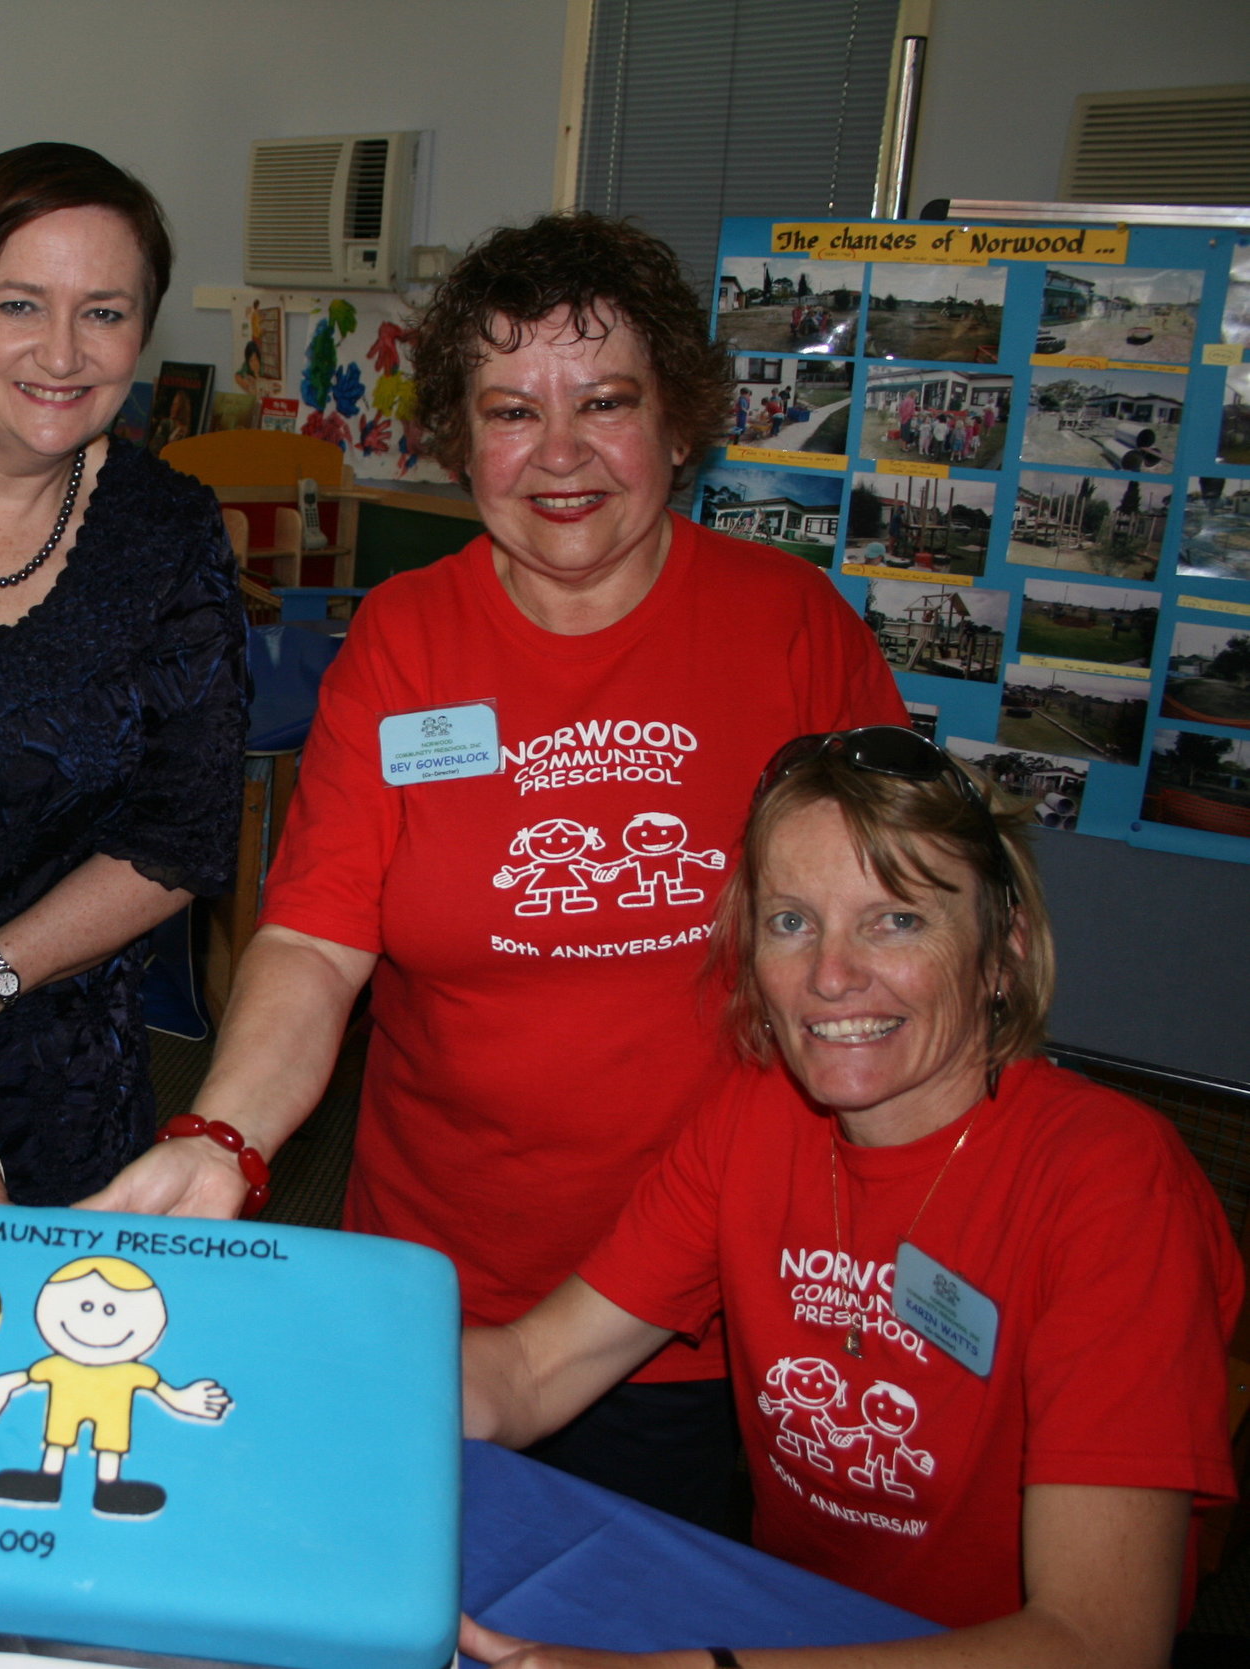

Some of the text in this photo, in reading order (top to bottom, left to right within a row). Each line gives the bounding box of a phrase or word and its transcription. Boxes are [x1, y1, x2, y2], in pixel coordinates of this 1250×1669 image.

[777, 230, 819, 250] The
[830, 226, 916, 251] changes
[931, 229, 955, 252] of
[970, 229, 1086, 254] Norwood
[390, 751, 489, 774] BEV GOWENLOCK
[500, 719, 698, 770] NORWOOD
[514, 749, 684, 785] COMMUNITY
[520, 766, 682, 797] PRESCHOOL
[491, 921, 717, 958] 50th ANNIVERSARY
[115, 1230, 288, 1261] PRESCHOOL
[791, 1284, 896, 1317] COMMUN
[794, 1303, 928, 1363] PRESCHOOL
[905, 1299, 937, 1326] KARIN
[941, 1321, 978, 1356] WATTS
[810, 1493, 927, 1536] ANNIVERSARY
